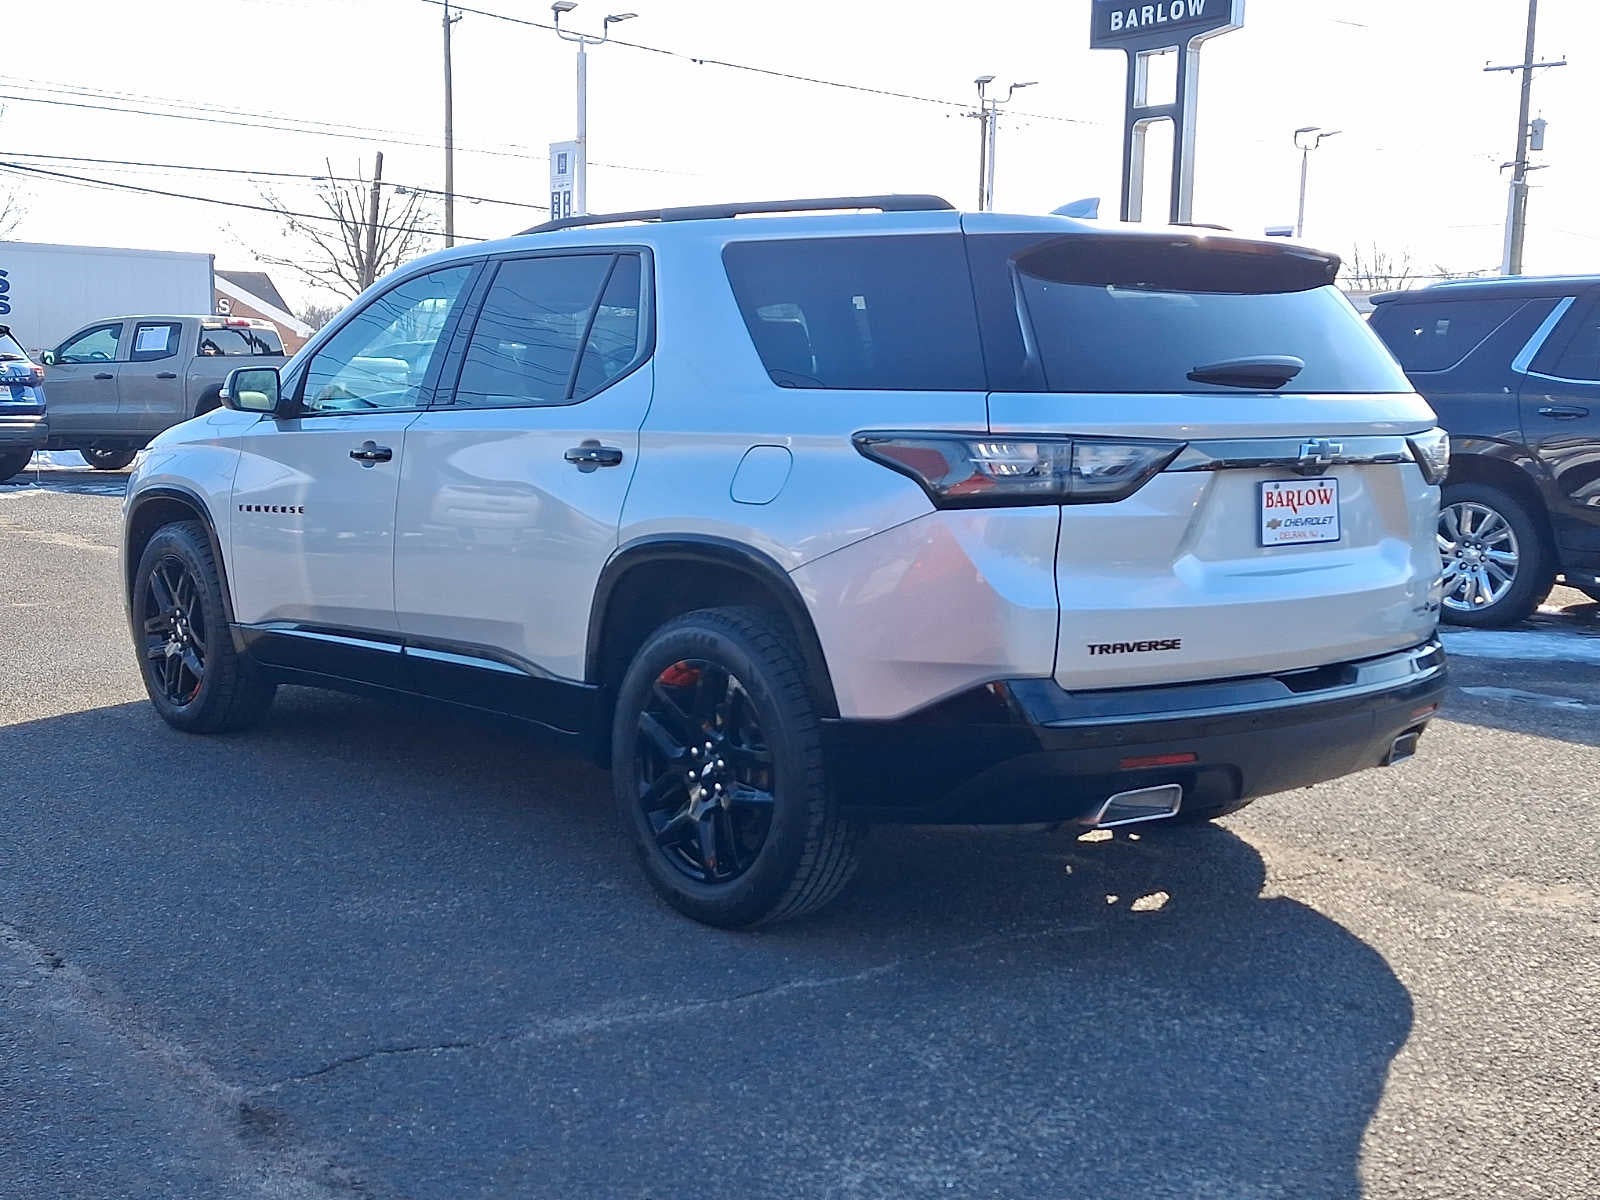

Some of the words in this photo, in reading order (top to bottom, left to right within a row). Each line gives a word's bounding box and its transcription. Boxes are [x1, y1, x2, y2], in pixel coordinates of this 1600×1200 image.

[1110, 0, 1205, 31] BARLOW
[238, 504, 304, 514] TRAVERSE
[1265, 488, 1334, 514] BARLOW
[1283, 516, 1335, 528] CHEVROLET
[1087, 638, 1182, 655] TRAVERSE
